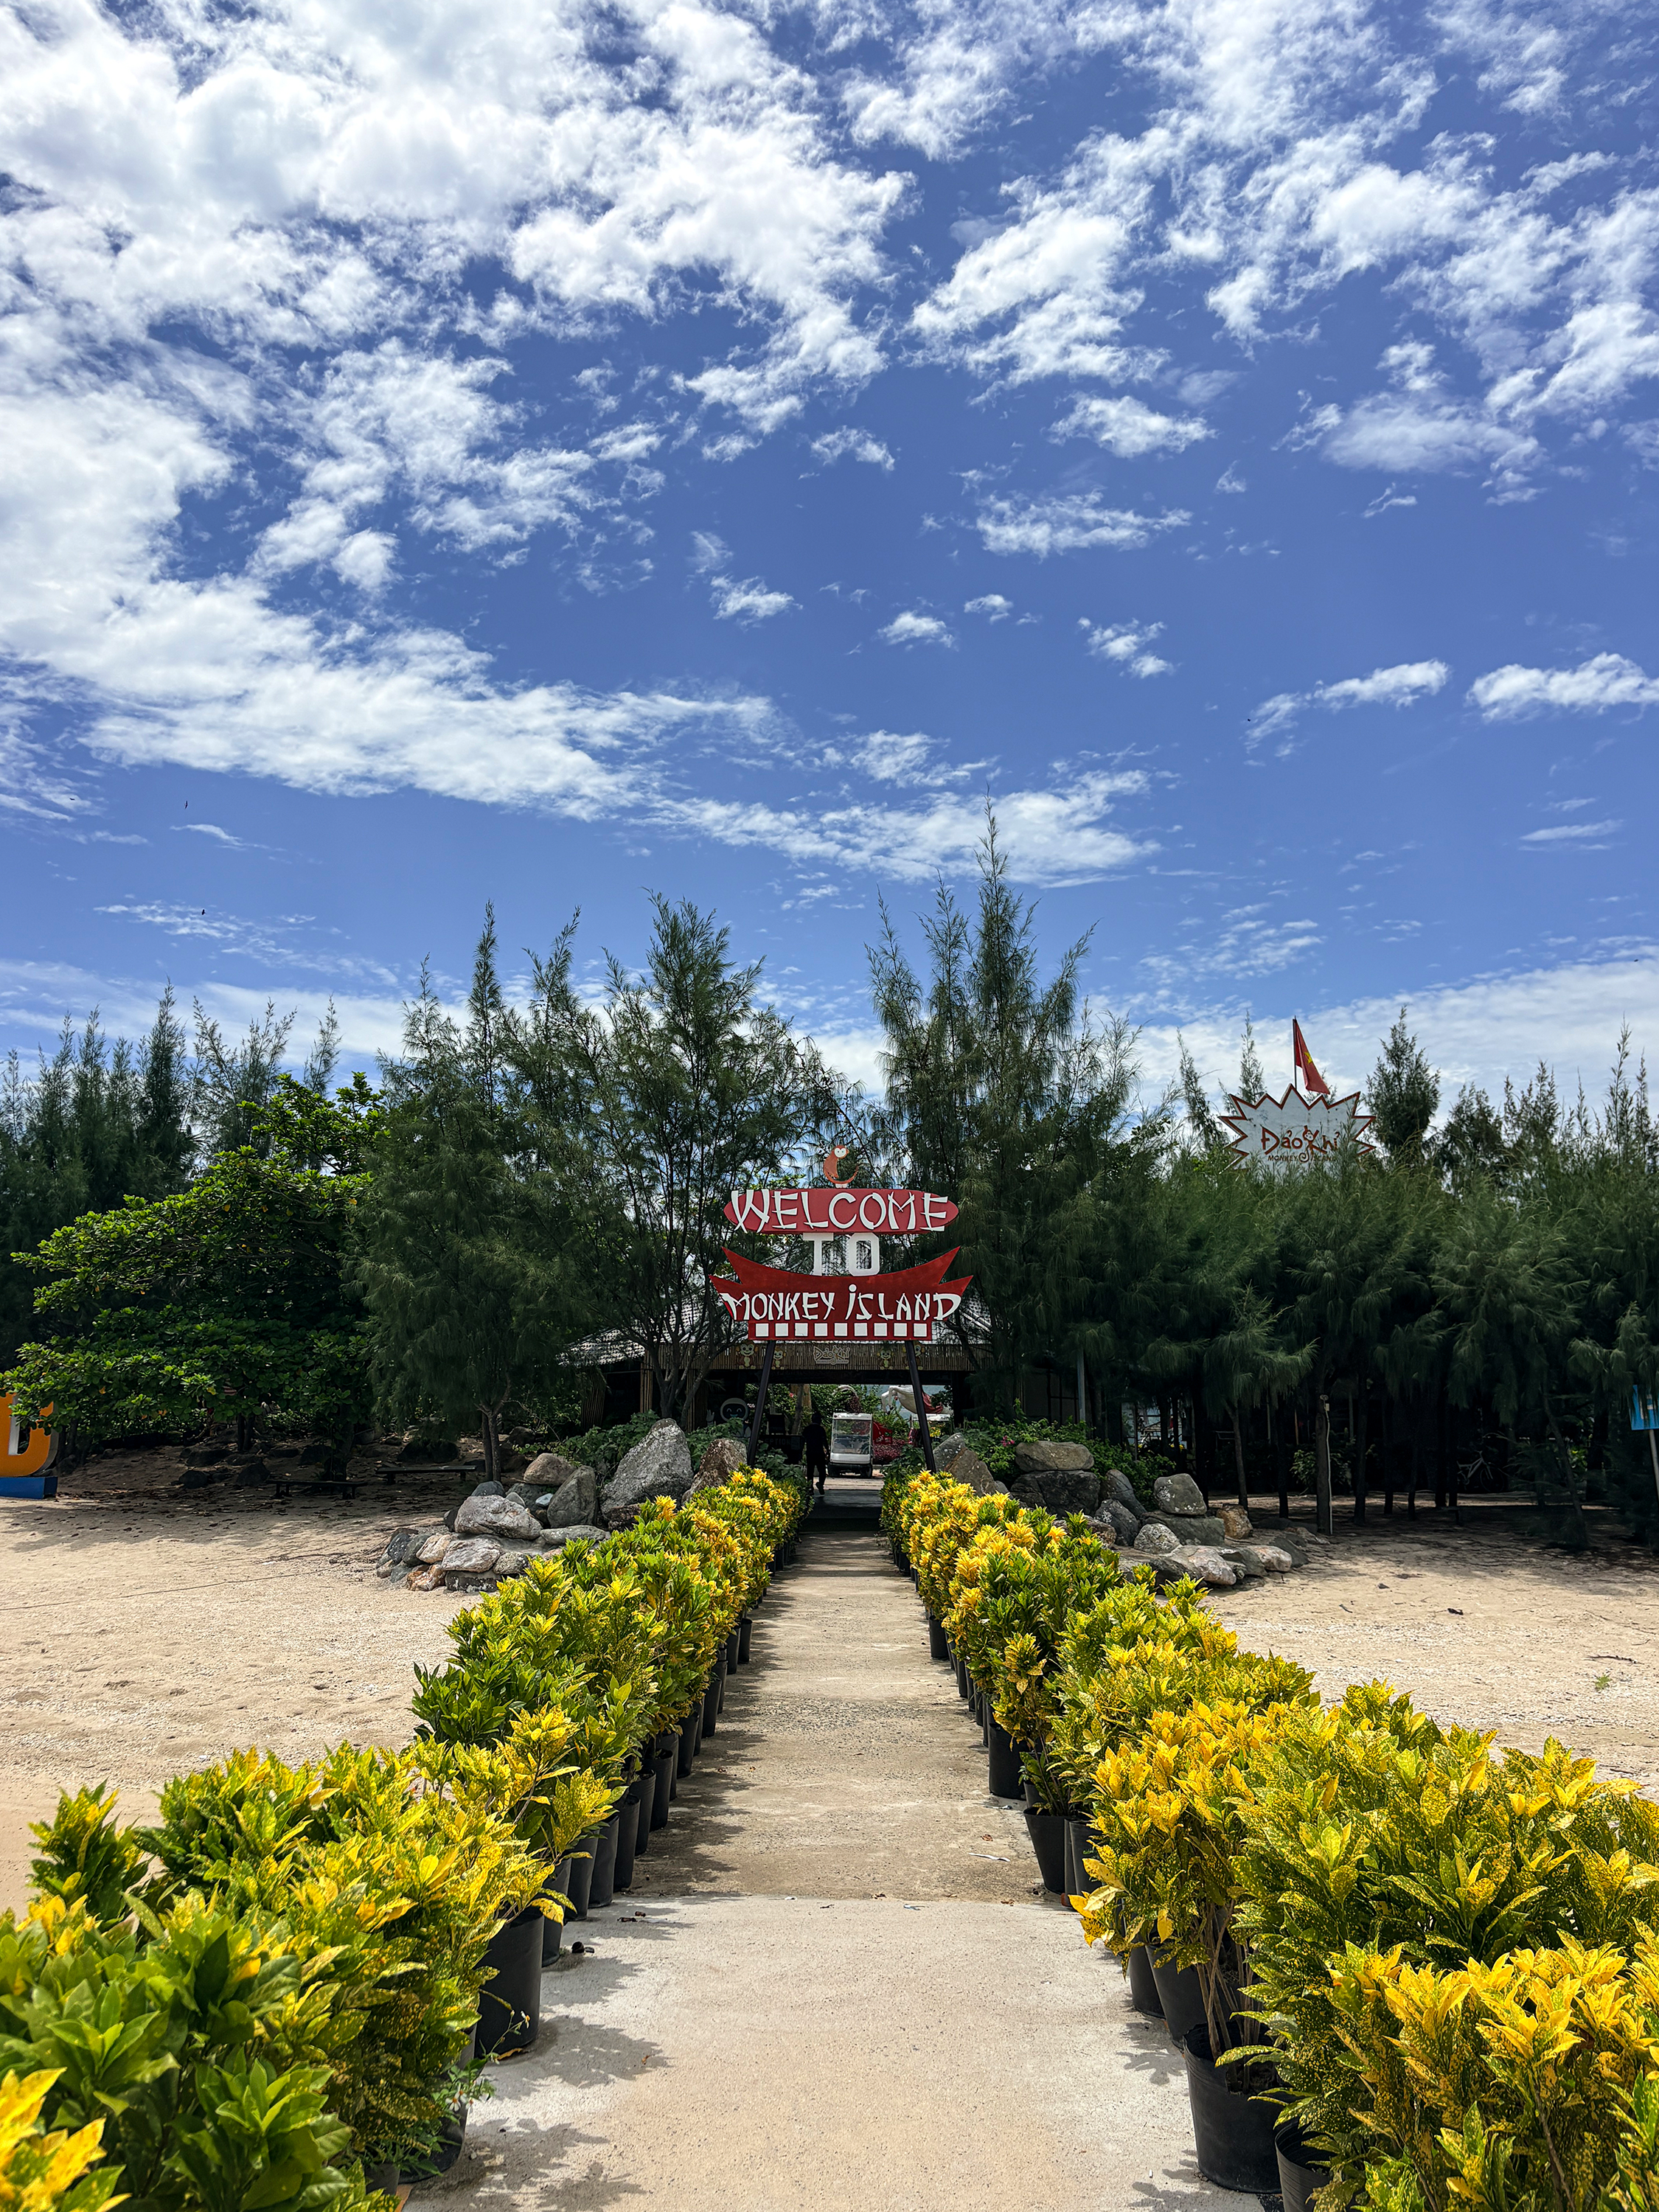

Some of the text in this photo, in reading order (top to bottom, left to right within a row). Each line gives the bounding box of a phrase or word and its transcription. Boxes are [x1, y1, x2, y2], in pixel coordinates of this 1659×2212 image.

[731, 1189, 948, 1234] WELCOME
[802, 1232, 880, 1276] TO
[720, 1292, 835, 1321] MONKEY
